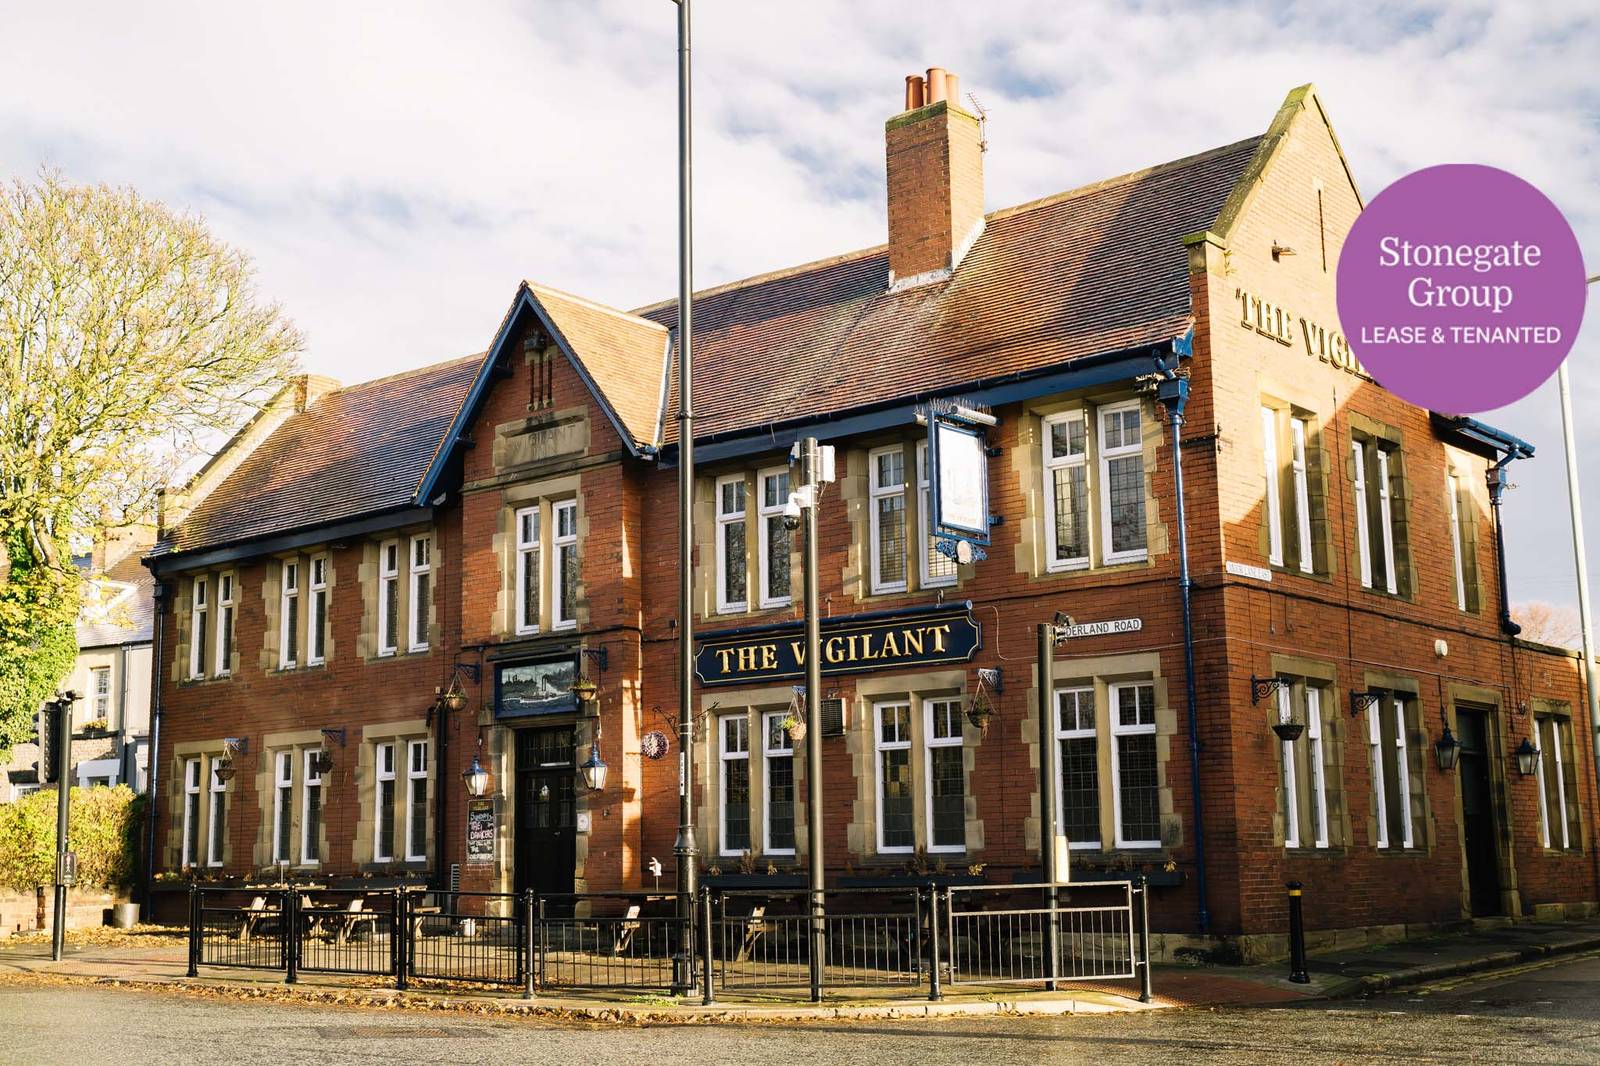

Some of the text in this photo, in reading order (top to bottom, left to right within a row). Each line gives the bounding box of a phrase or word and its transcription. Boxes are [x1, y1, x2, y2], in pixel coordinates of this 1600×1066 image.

[1235, 287, 1293, 348] THE
[715, 624, 950, 674] THE VGILANT
[1114, 619, 1140, 631] ROAD
